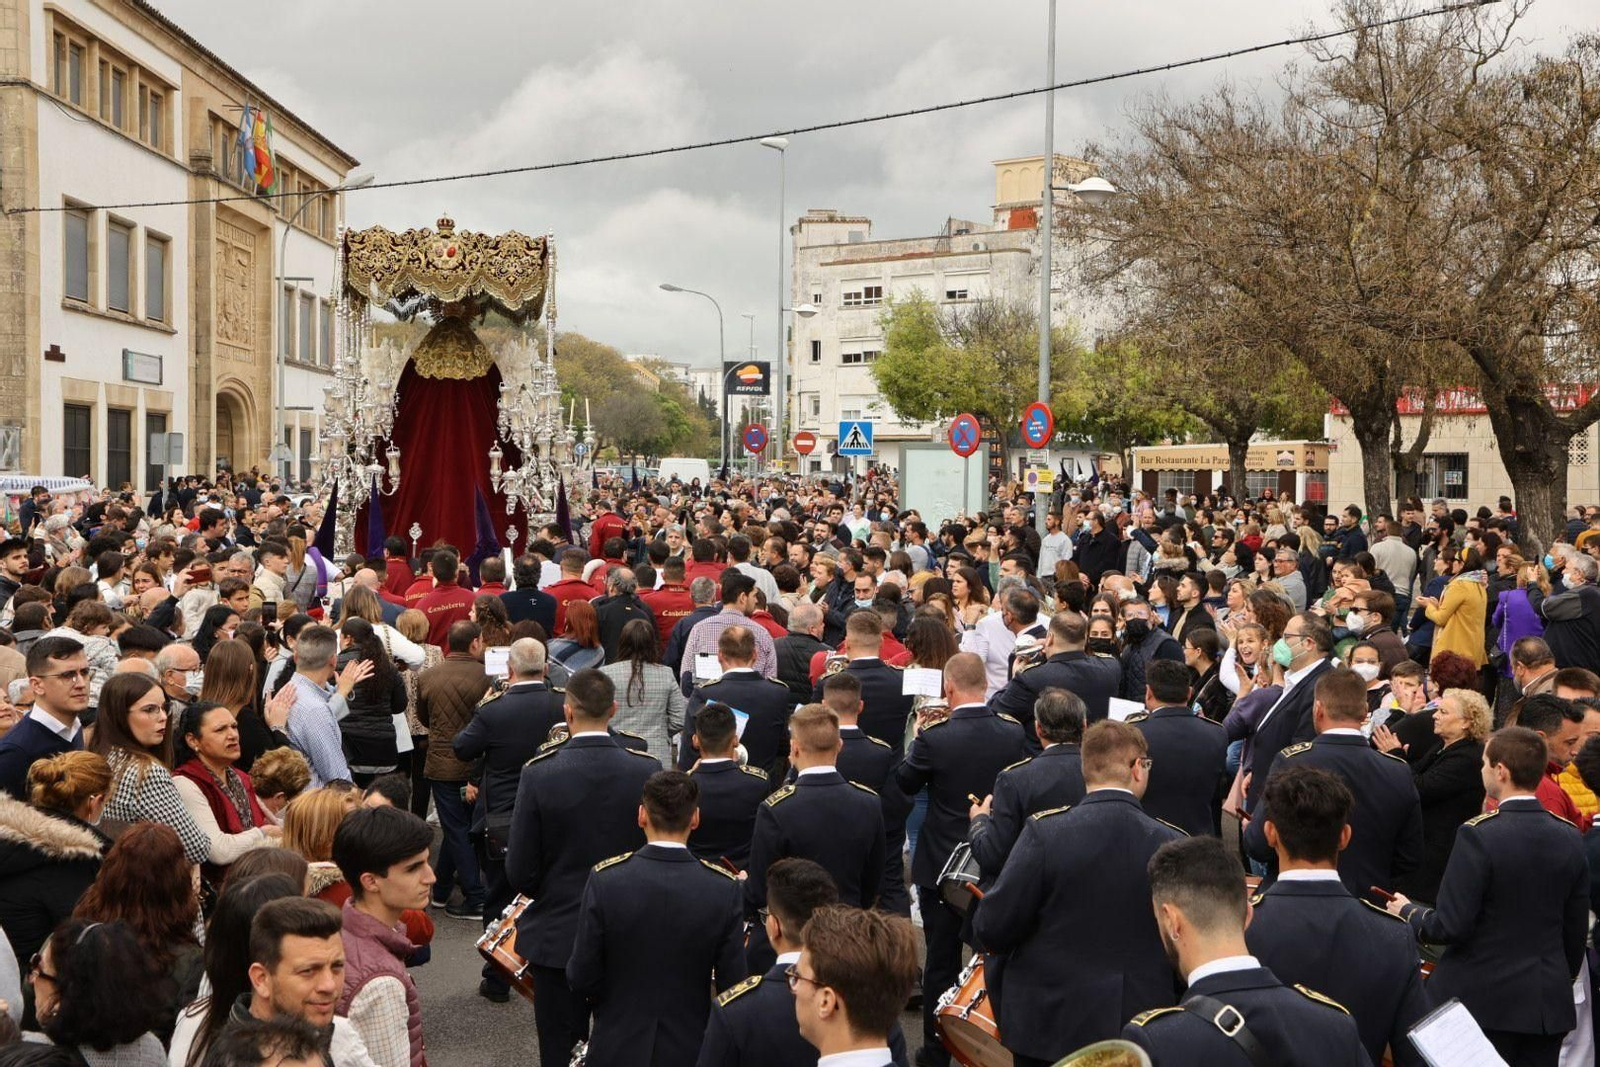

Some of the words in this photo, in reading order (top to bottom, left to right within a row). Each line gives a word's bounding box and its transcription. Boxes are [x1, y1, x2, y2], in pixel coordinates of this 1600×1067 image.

[1140, 456, 1153, 464] Bar
[1155, 455, 1199, 464] Restaurante
[1200, 455, 1210, 464] La
[1212, 455, 1230, 464] Para
